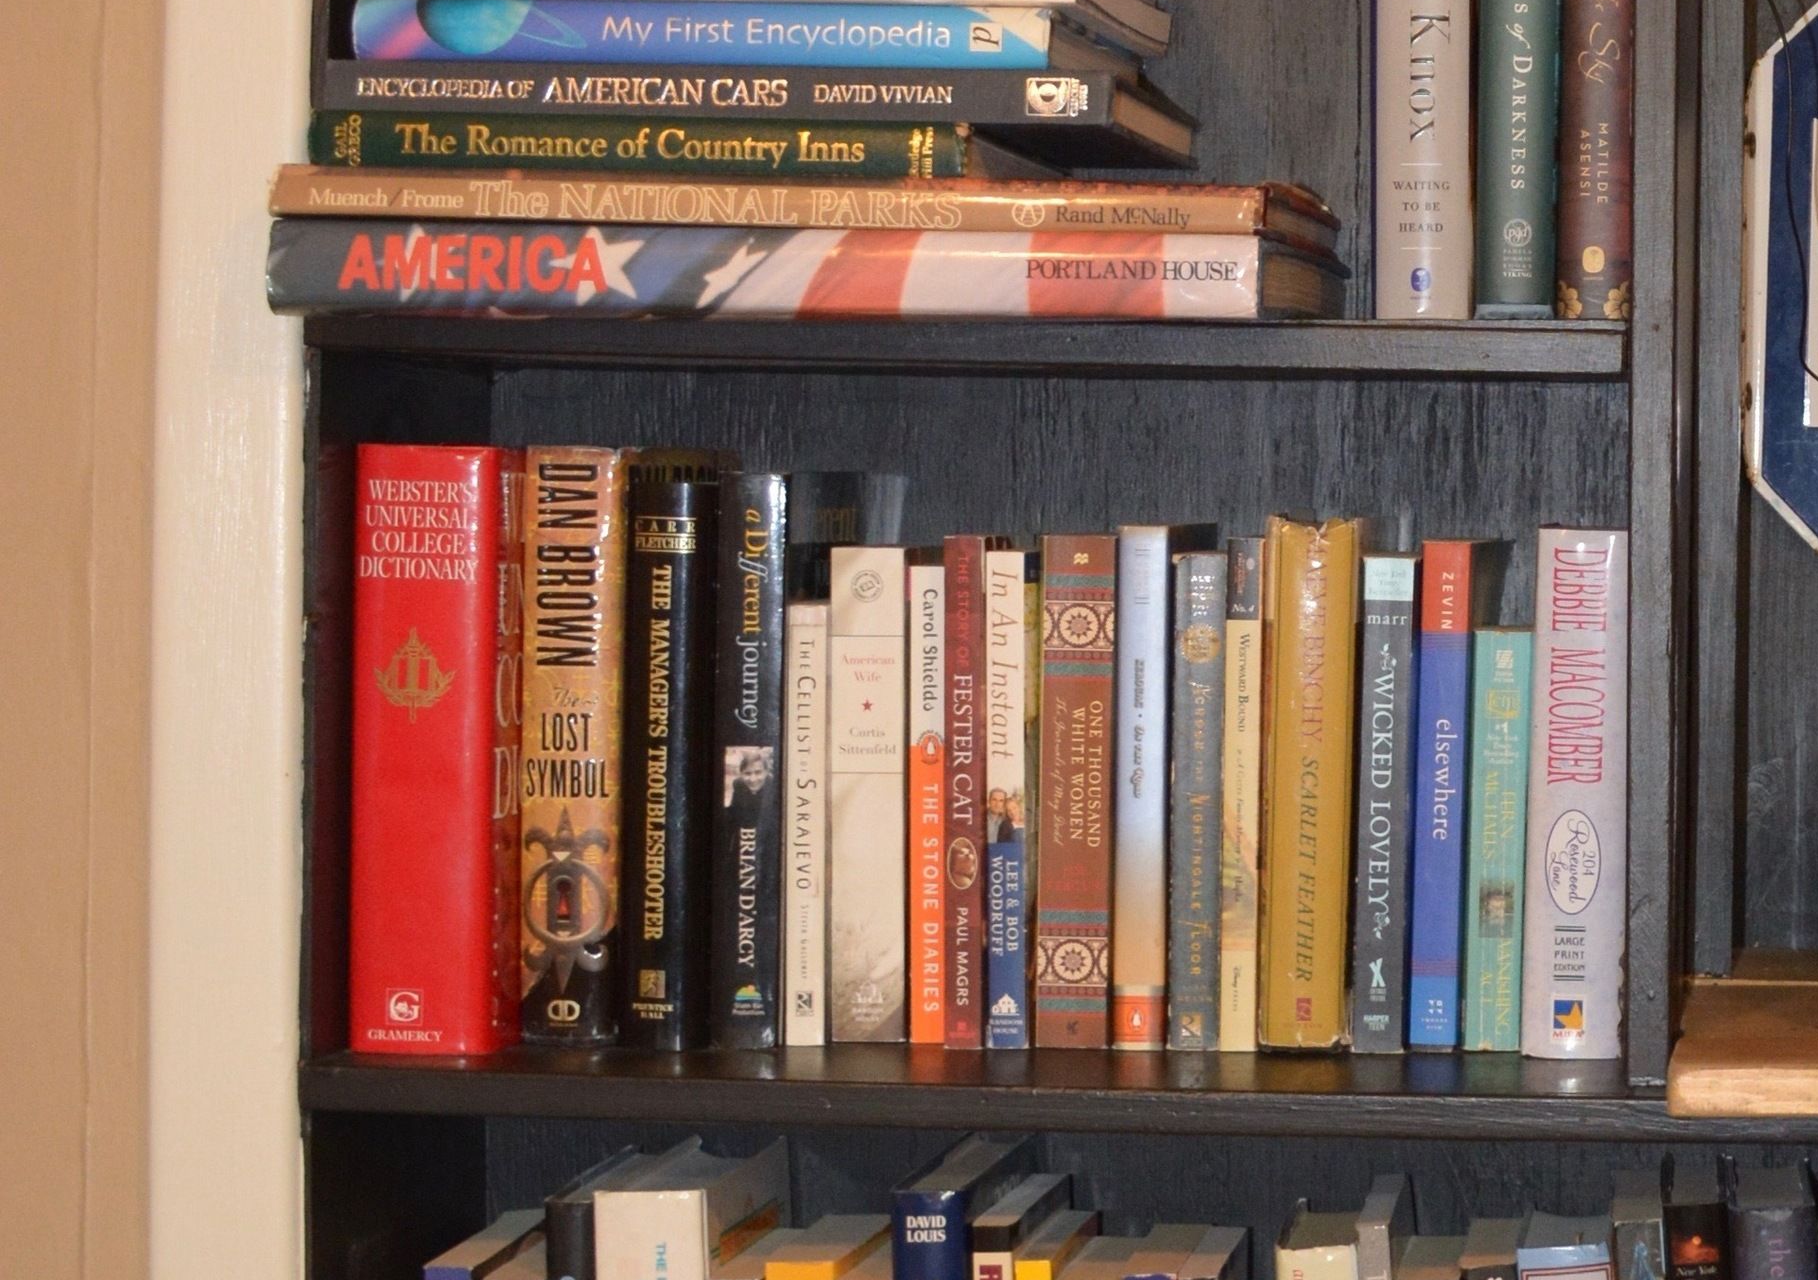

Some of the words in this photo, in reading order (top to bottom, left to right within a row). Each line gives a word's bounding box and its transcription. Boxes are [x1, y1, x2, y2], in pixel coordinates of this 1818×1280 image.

[603, 16, 647, 46] My
[665, 16, 734, 44] First
[747, 19, 951, 48] Encyclopedia
[358, 78, 505, 98] ENCYCLOPEDIA
[508, 81, 535, 98] OF
[543, 77, 702, 105] AMERICAN
[711, 79, 788, 106] CARS
[814, 86, 877, 103] DAVID
[880, 86, 953, 103] VIVIAN
[1409, 11, 1451, 143] Knox
[1511, 55, 1533, 190] DARKNESS
[395, 124, 456, 154] The
[467, 125, 607, 157] Romance
[657, 129, 787, 167] Country
[798, 132, 865, 163] Inns
[1578, 131, 1590, 198] ASENSI
[1596, 124, 1609, 204] MATILDE
[1393, 181, 1451, 191] WAITING
[1402, 202, 1419, 211] TO
[1424, 202, 1440, 211] BE
[1056, 205, 1103, 224] Rand
[1111, 206, 1190, 228] McNally
[1399, 223, 1443, 233] HEARD
[338, 233, 607, 292] AMERICA
[1026, 259, 1157, 280] PORTLAND
[1161, 261, 1238, 281] HOUSE
[368, 479, 476, 504] WEBSTER'S
[537, 462, 600, 530] DAN
[365, 507, 476, 529] UNIVERSAL
[372, 531, 465, 554] COLLEGE
[360, 556, 477, 584] DICTIONARY
[536, 544, 602, 667] BROWN
[922, 589, 938, 640] Carol
[1441, 571, 1454, 630] ZEVIN
[922, 647, 938, 712] Shields
[541, 714, 591, 752] LOST
[952, 675, 973, 776] FESTER
[1371, 676, 1395, 789] WICKED
[525, 759, 609, 799] SYMBOL
[1432, 719, 1457, 842] elsewhere
[922, 784, 939, 825] THE
[953, 781, 973, 825] CAT
[924, 839, 939, 910] STONE
[1368, 801, 1391, 909] LOVELY
[956, 907, 968, 945] PAUL
[1554, 937, 1585, 946] LARGE
[924, 921, 940, 1014] DIARIES
[1555, 950, 1585, 960] PRINT
[955, 951, 968, 1006] MAGRS
[368, 1029, 443, 1043] GRAMERCY
[906, 1216, 946, 1229] DAVID
[906, 1230, 946, 1242] LOUIS
